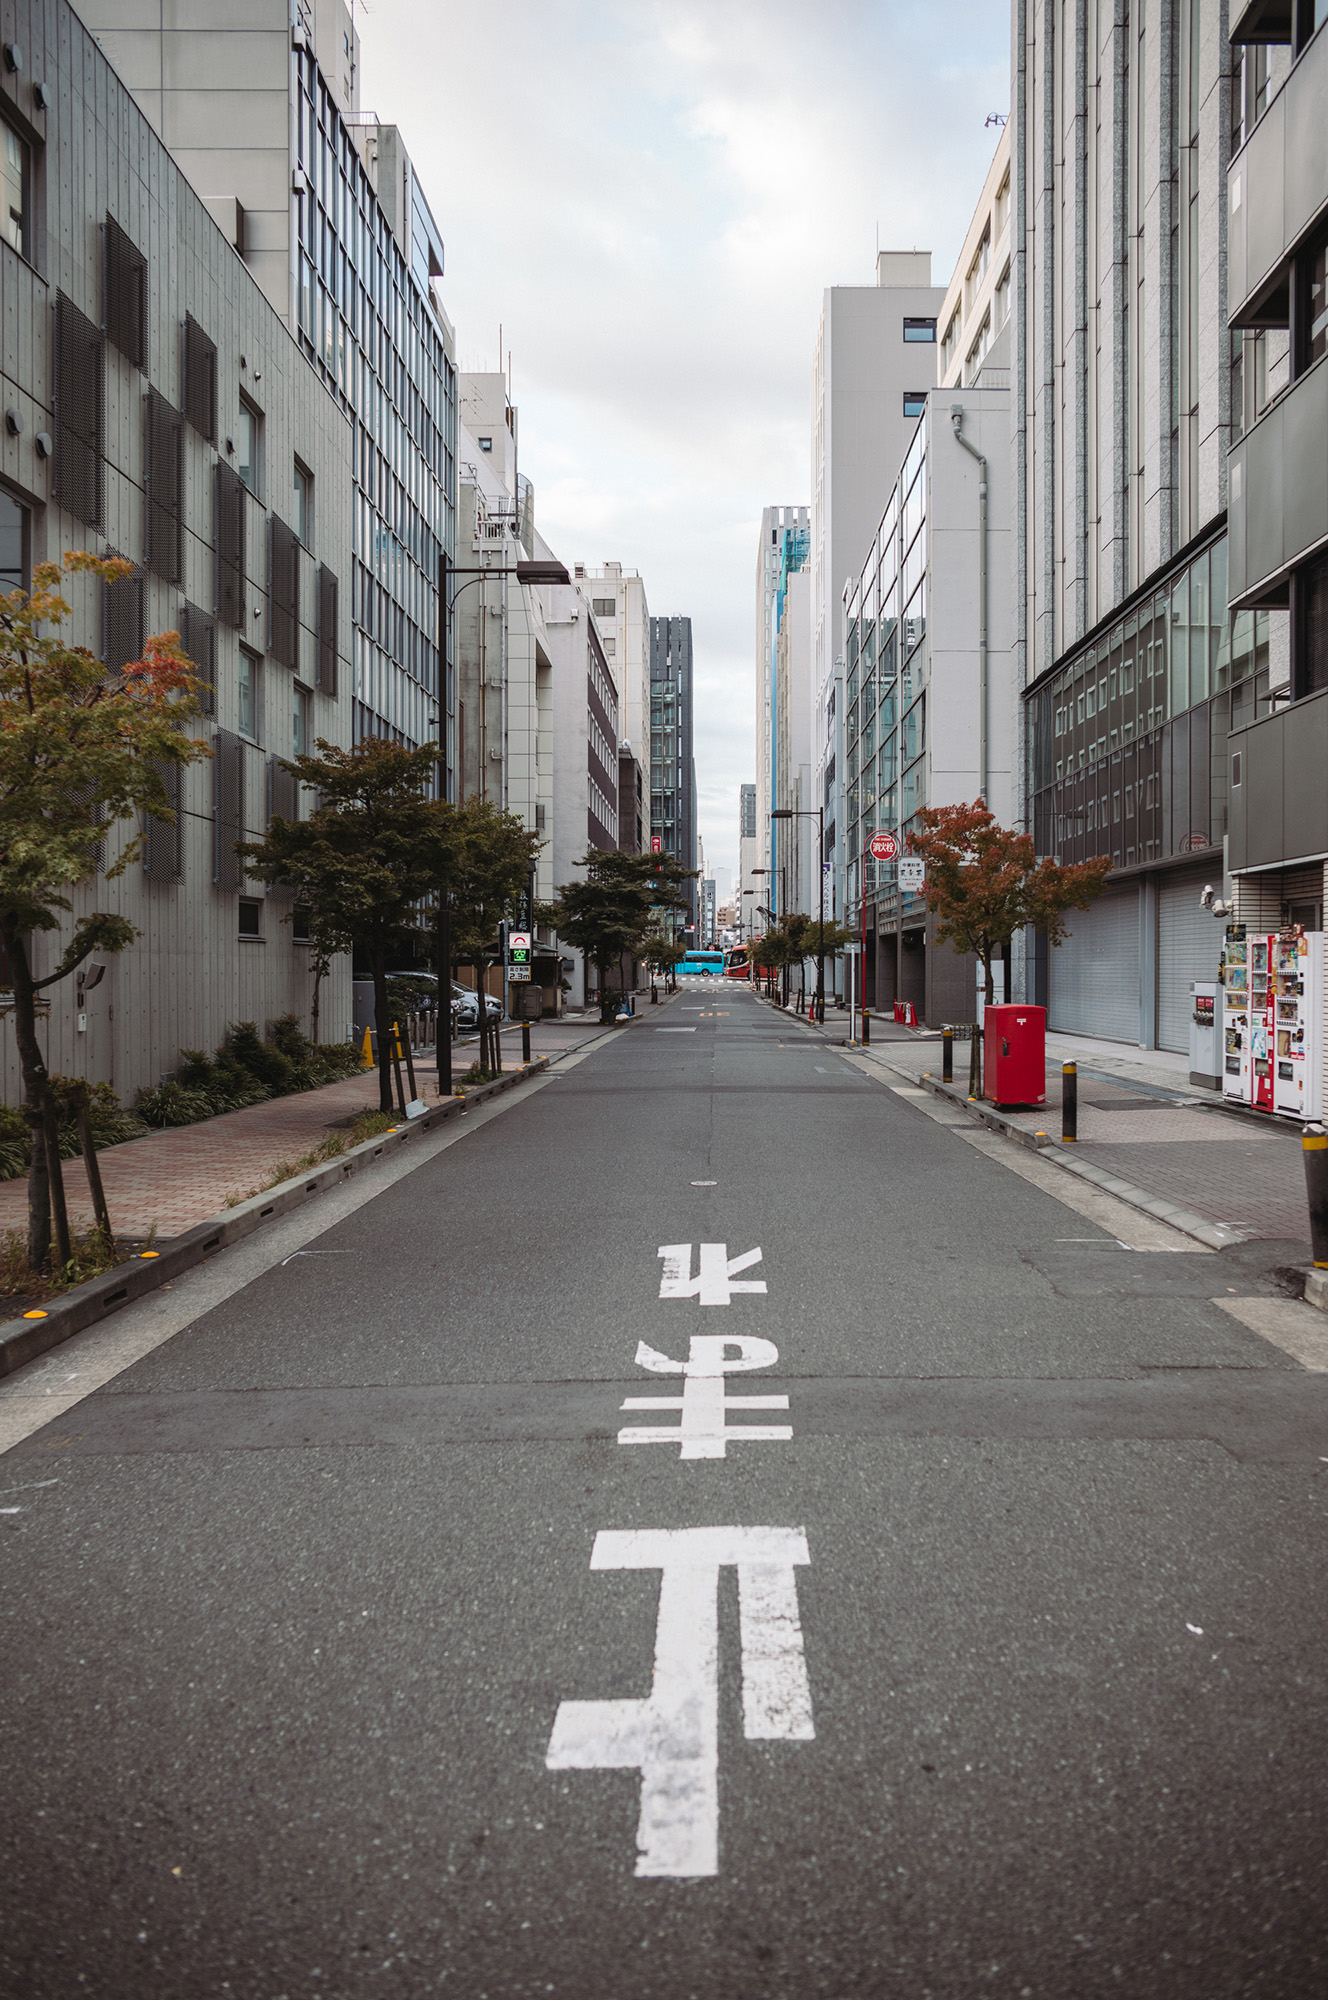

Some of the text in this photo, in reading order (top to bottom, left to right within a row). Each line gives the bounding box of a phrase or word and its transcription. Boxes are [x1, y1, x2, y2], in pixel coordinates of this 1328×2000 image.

[873, 842, 894, 853] 消火栓
[513, 949, 526, 961] 空
[545, 1242, 816, 1878] 止まれ
